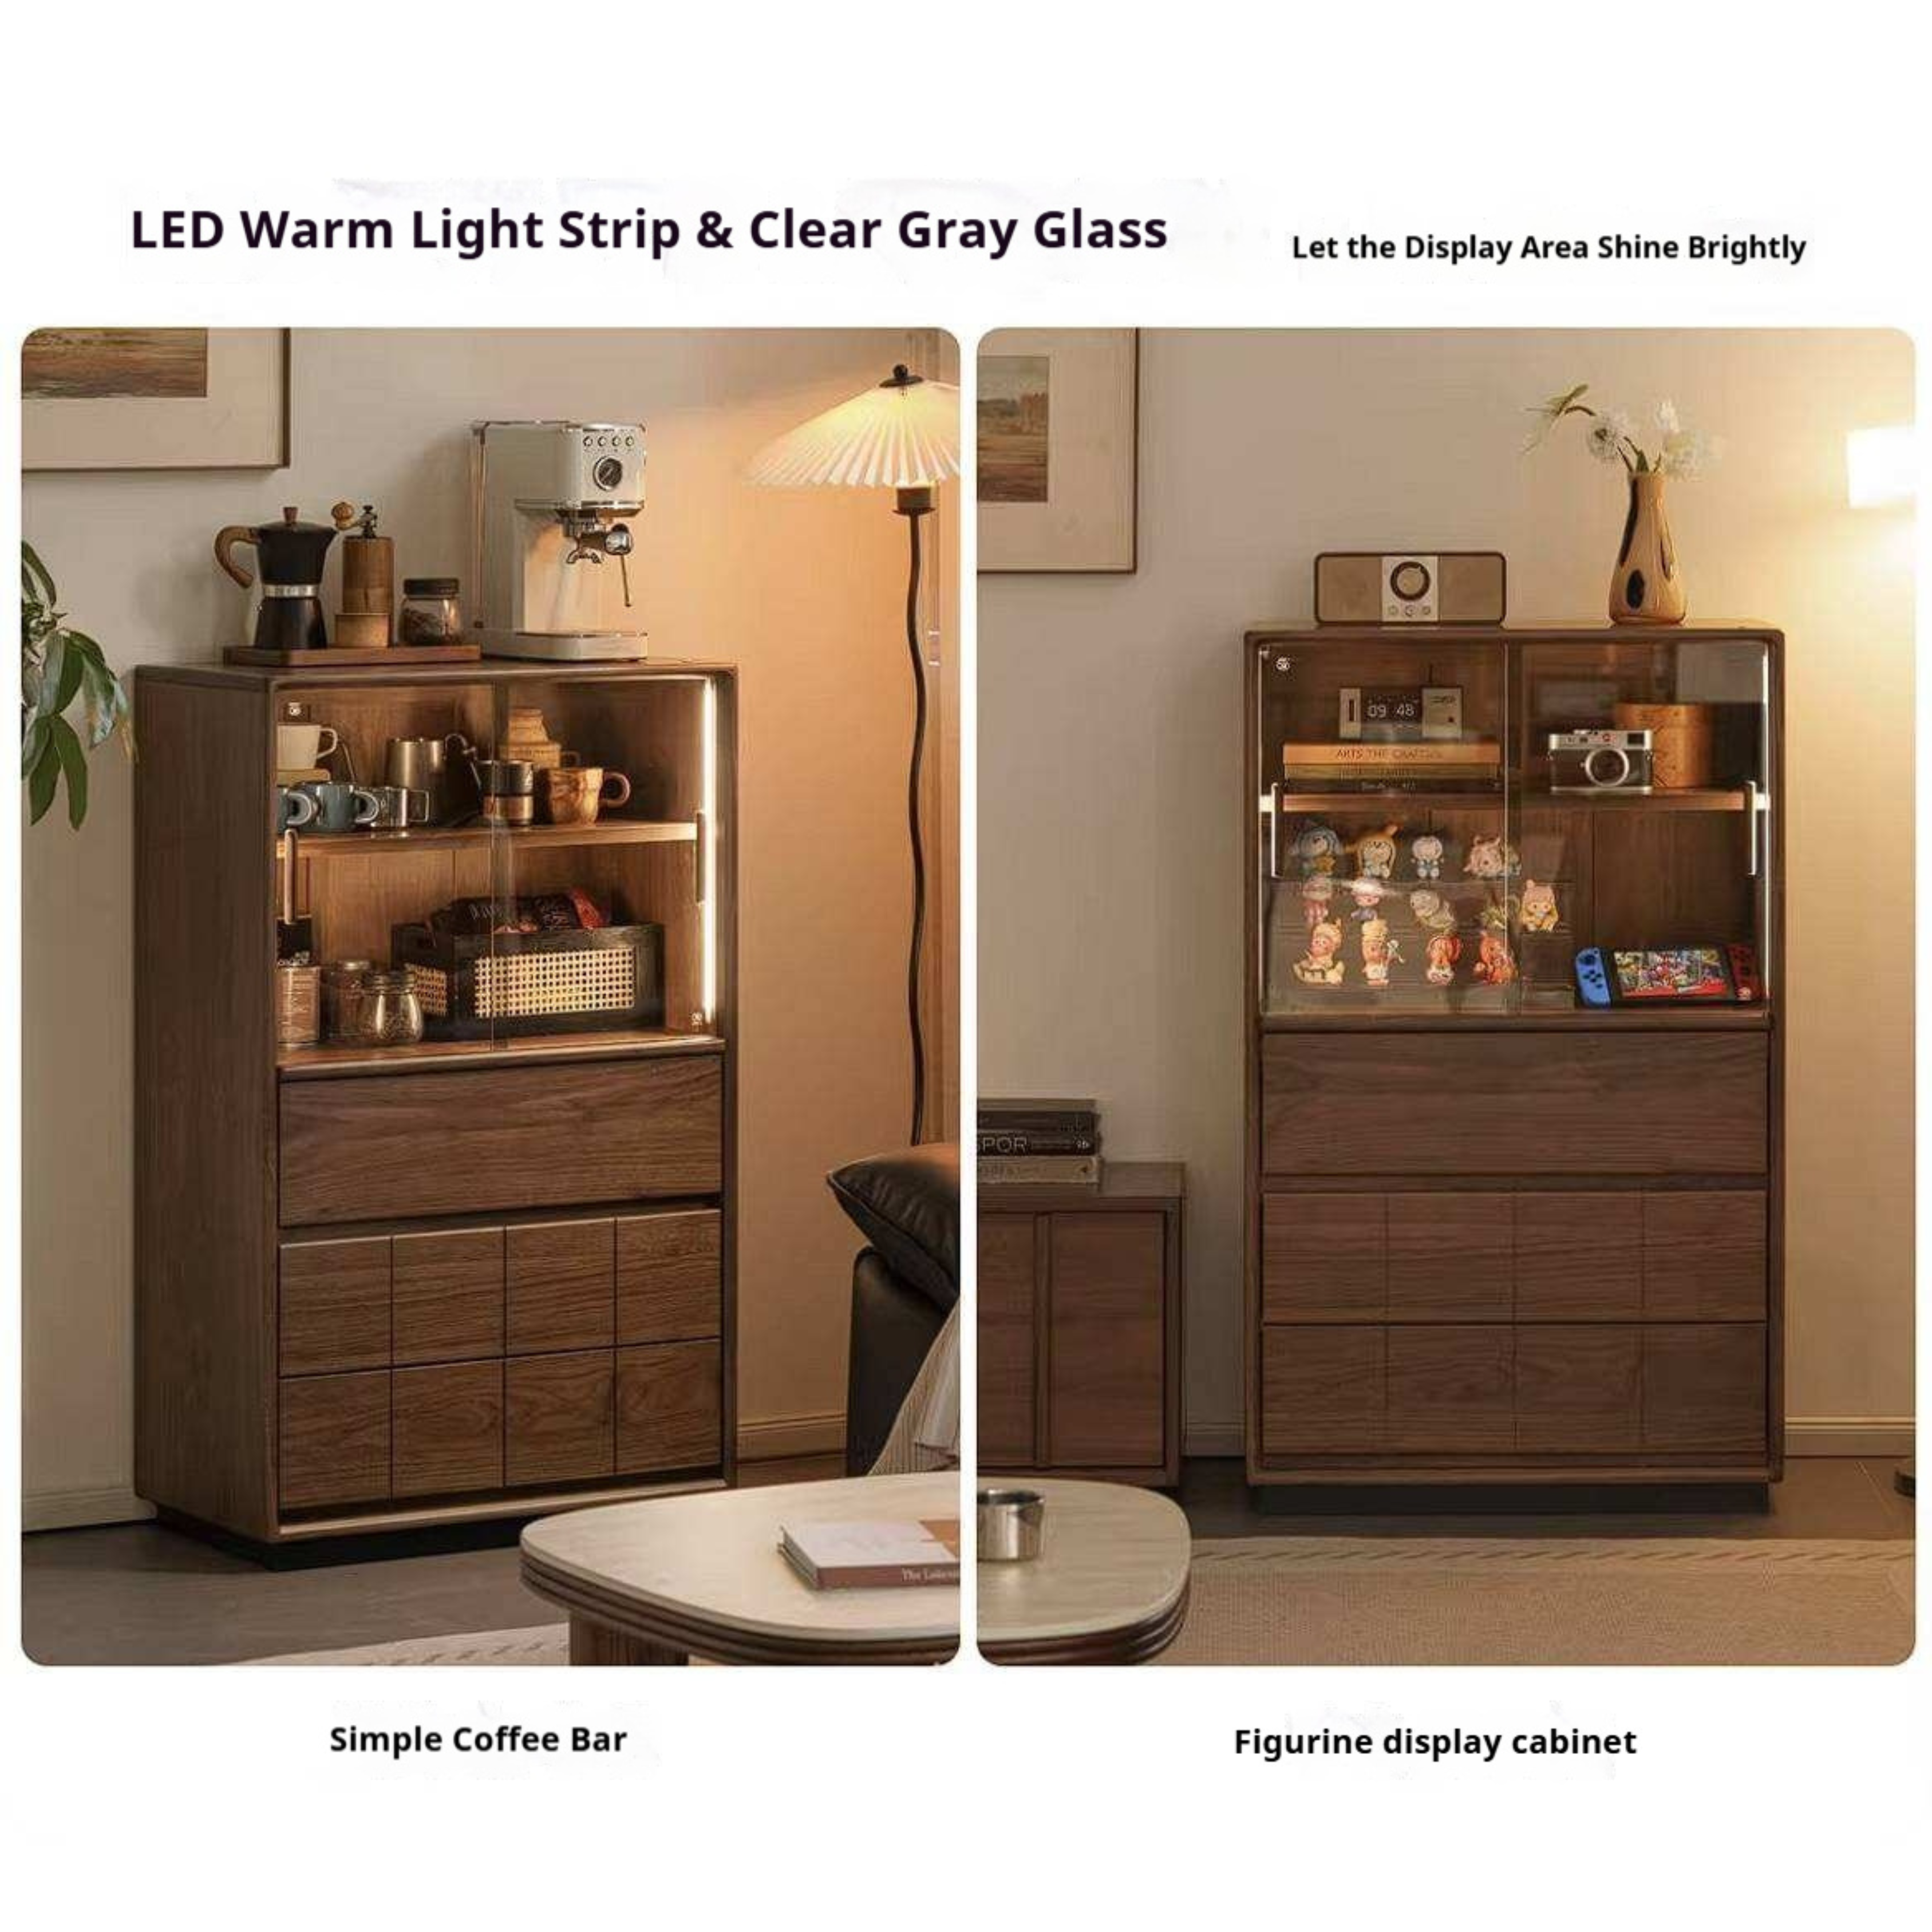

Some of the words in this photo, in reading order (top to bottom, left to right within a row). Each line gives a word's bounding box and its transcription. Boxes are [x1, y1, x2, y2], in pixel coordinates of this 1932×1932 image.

[1368, 704, 1387, 718] 09
[1397, 703, 1415, 717] 48
[977, 1136, 1028, 1153] POR
